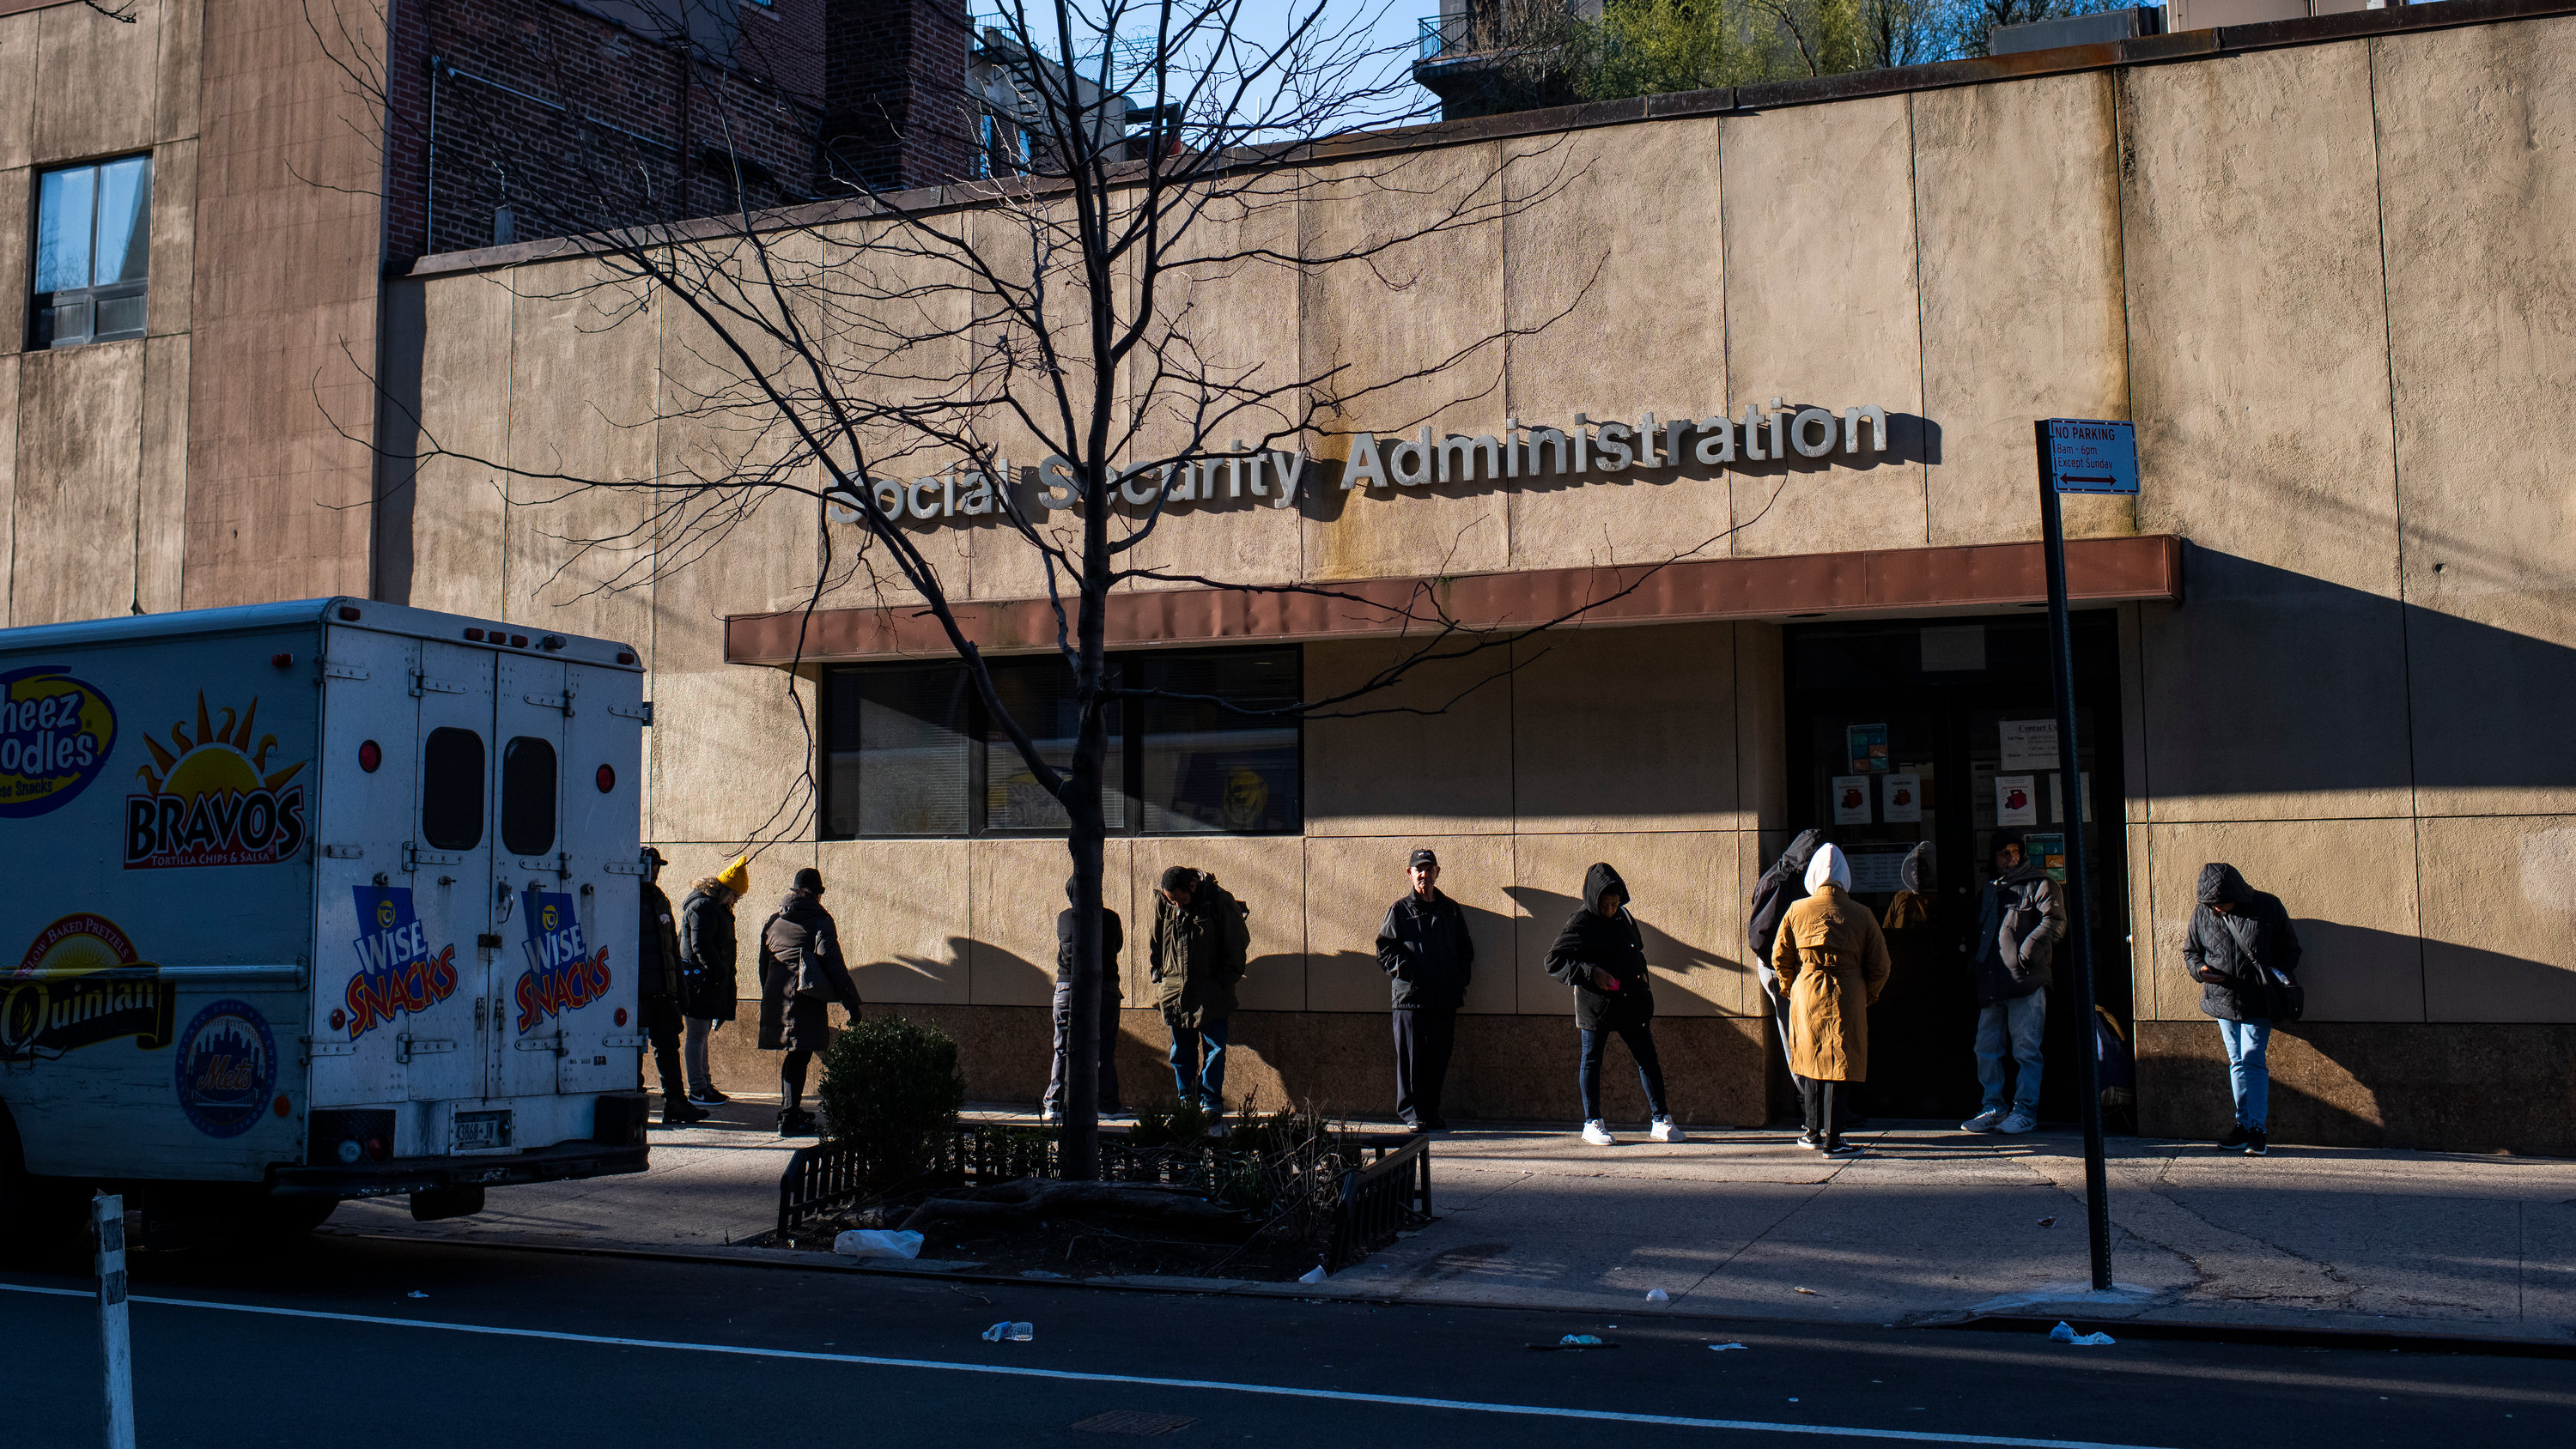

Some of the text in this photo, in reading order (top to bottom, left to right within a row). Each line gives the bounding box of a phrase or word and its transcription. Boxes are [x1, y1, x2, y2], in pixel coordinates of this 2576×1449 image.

[829, 458, 1011, 524] Social
[1340, 396, 1887, 490] Administration
[2055, 427, 2116, 441] NO PARKING
[2057, 444, 2074, 454] 8am
[2081, 445, 2098, 457] 6pm
[2058, 457, 2113, 471] Except Sunday
[15, 777, 53, 797] Snacks
[126, 789, 303, 862] BRAVOS
[151, 852, 270, 867] TORTILLA CHIPS & SALSA
[21, 917, 131, 974] SLOW BAKED PRETZELS
[355, 920, 427, 975] WISE
[523, 924, 585, 975] WISE
[346, 944, 458, 1039] SNACKS
[516, 946, 611, 1033] SNACKS
[0, 979, 155, 1059] Quinlan
[196, 1054, 254, 1091] Mets
